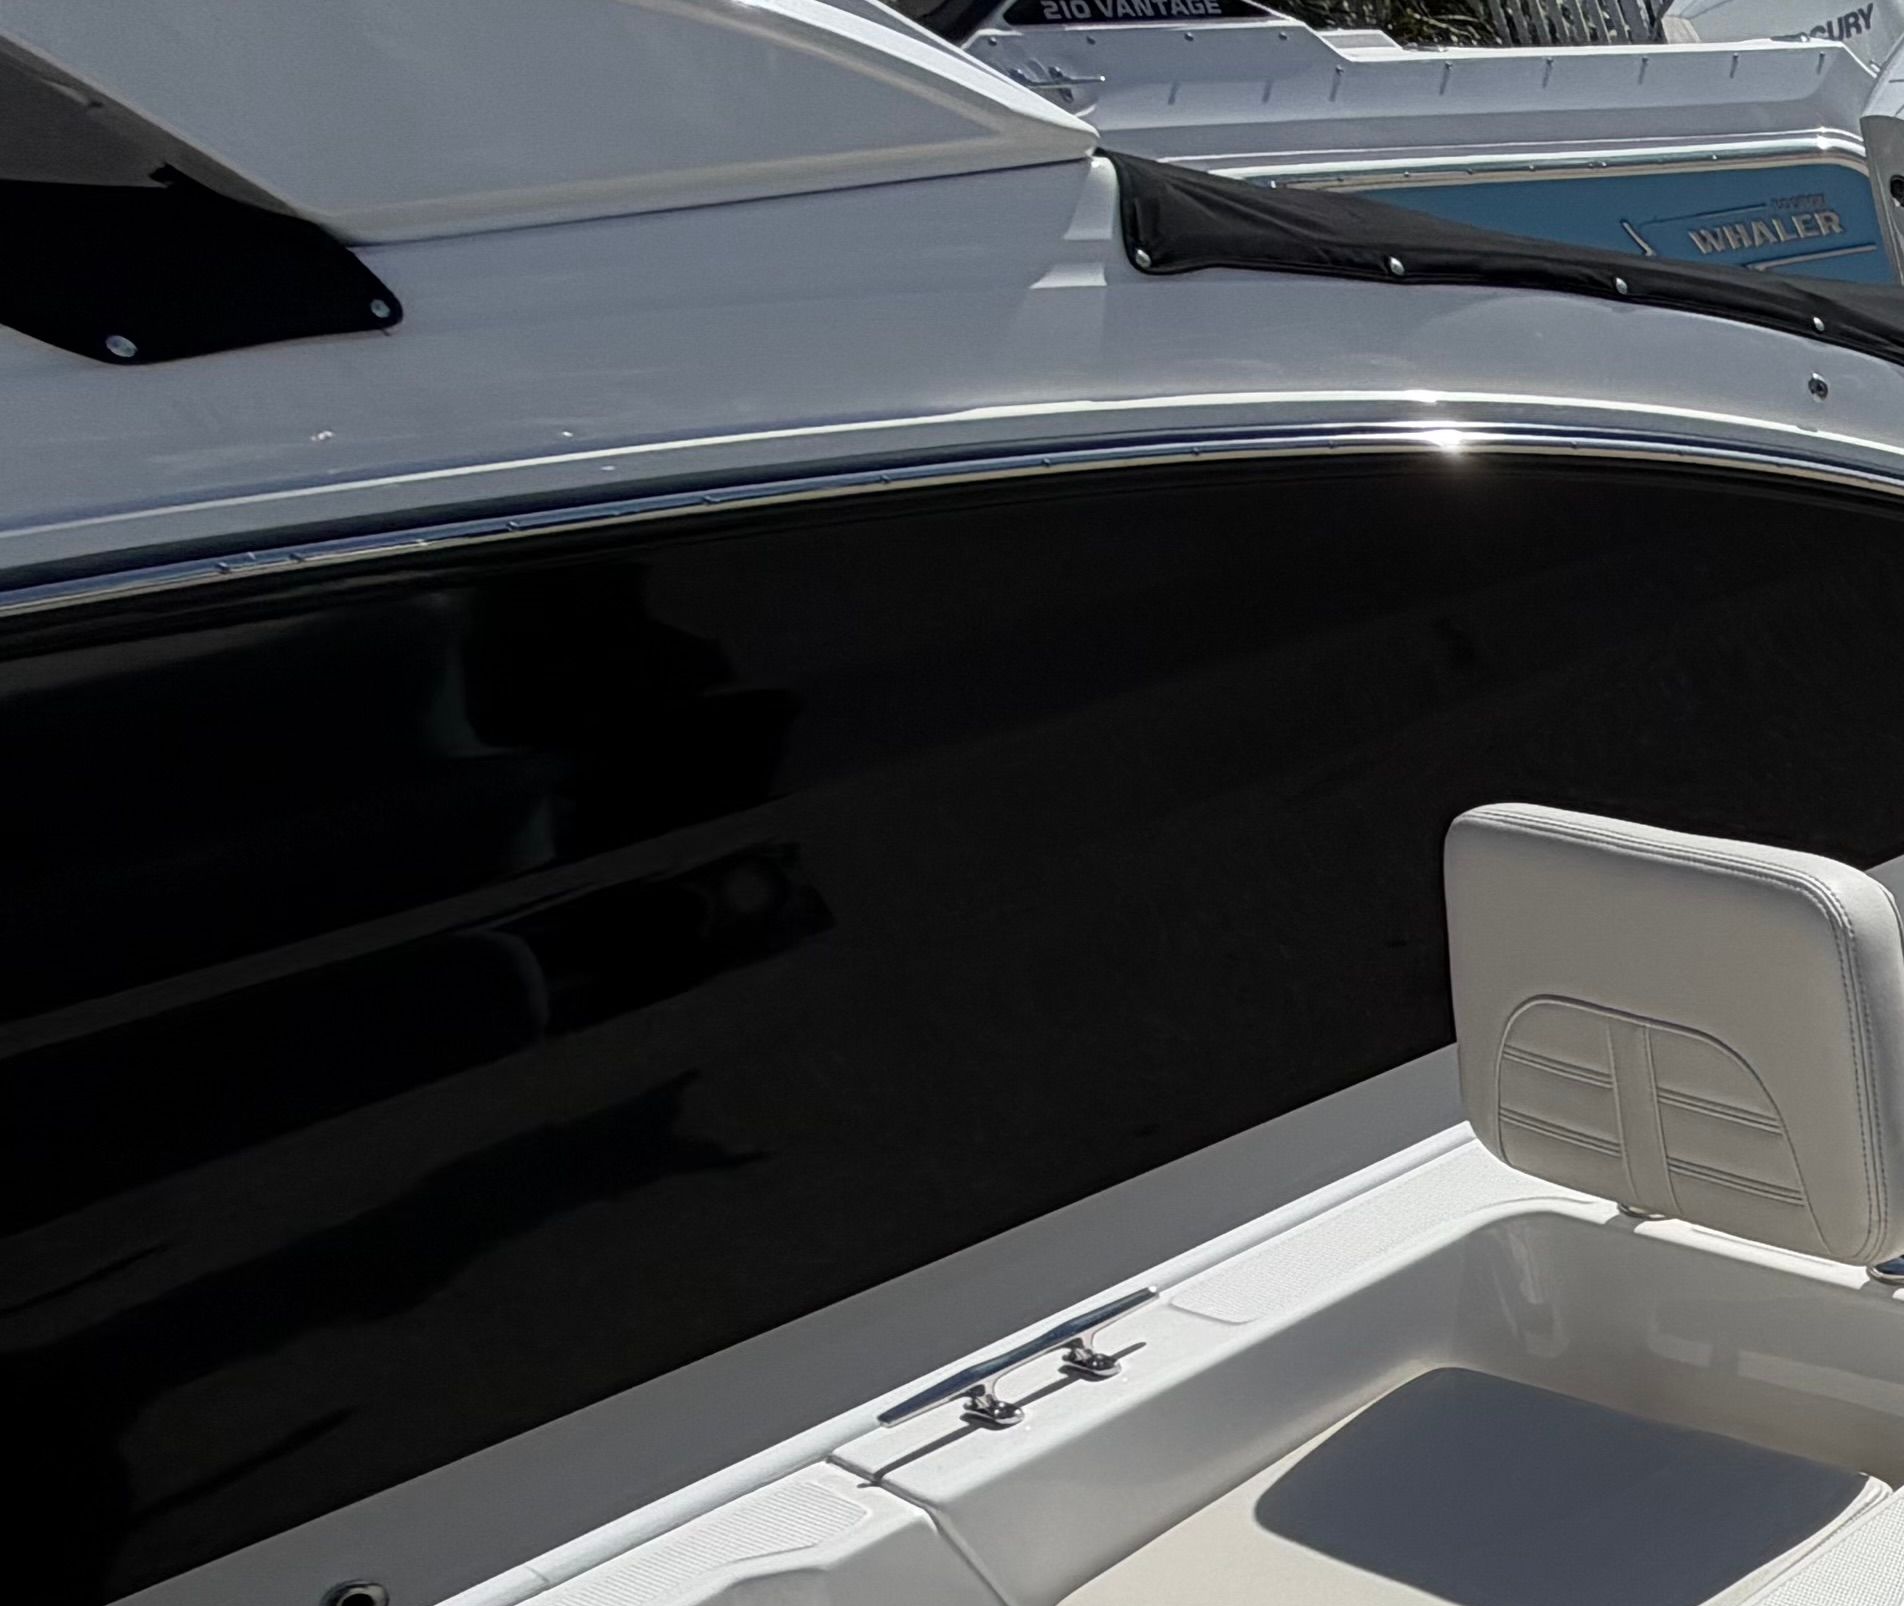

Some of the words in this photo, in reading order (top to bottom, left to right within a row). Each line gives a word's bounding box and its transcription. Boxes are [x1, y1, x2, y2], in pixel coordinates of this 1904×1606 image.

[1043, 0, 1091, 20] 210
[1096, 0, 1222, 18] VANTAGE
[1809, 2, 1874, 41] CURY
[1688, 210, 1845, 254] WHALER
